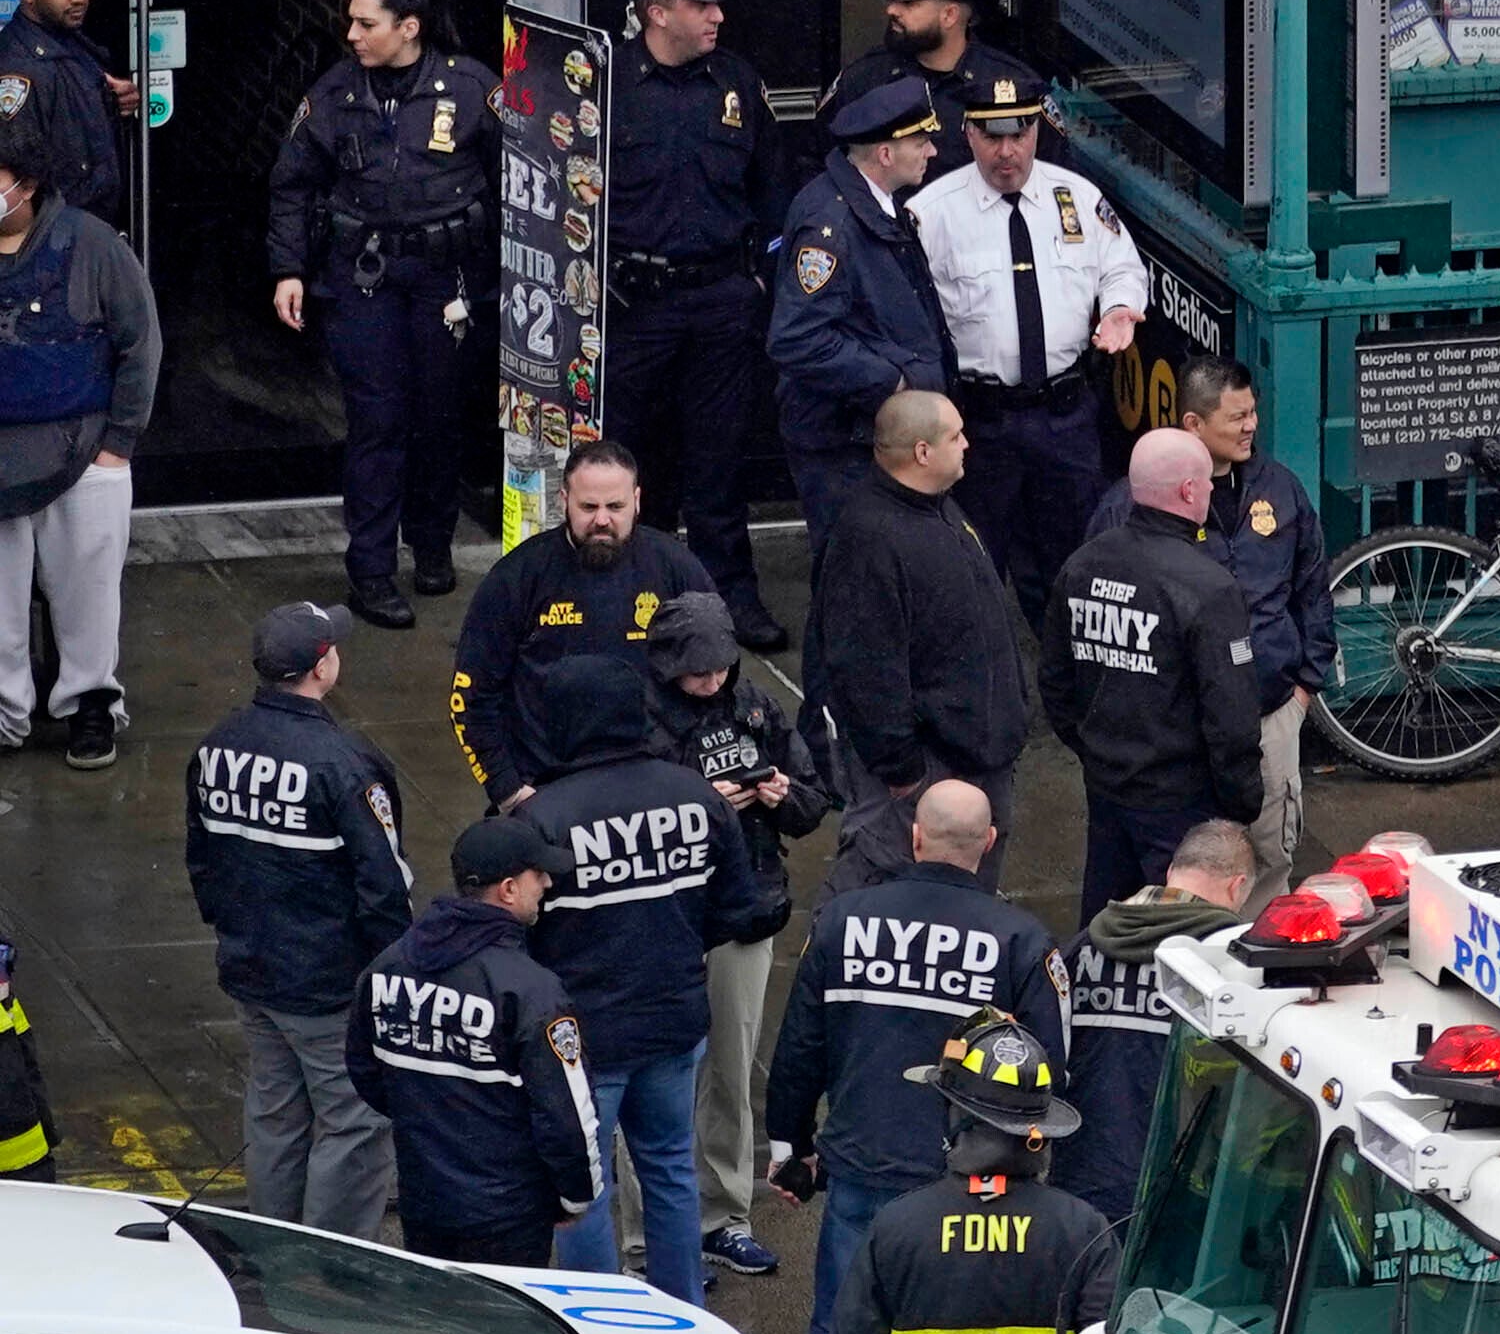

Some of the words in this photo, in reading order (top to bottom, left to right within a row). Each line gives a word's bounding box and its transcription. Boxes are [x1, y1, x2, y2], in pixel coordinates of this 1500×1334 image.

[1162, 273, 1221, 357] Station
[1360, 351, 1412, 367] Bicycles
[1417, 351, 1430, 361] or
[1434, 348, 1467, 361] other
[1360, 366, 1416, 382] attached
[1420, 367, 1433, 378] to
[1438, 364, 1472, 376] these
[1360, 385, 1377, 398] be
[1381, 381, 1435, 397] removed
[1439, 380, 1462, 393] and
[1361, 400, 1380, 414] the
[1385, 398, 1413, 412] Lost
[1417, 395, 1470, 413] Property
[1474, 392, 1499, 406] Unit
[1360, 415, 1407, 430] located
[1411, 415, 1423, 427] at
[1428, 412, 1445, 425] 34
[1450, 411, 1464, 424] St
[1395, 429, 1426, 444] (212)
[1090, 577, 1137, 604] CHIEF
[540, 613, 583, 626] POLICE
[548, 602, 574, 616] ATF
[1068, 597, 1159, 652] FDNY
[199, 746, 308, 804] NYPD
[704, 751, 740, 774] ATF
[199, 786, 308, 830] POLICE
[569, 802, 709, 866] NYPD
[575, 843, 709, 890] POLICE
[843, 916, 1000, 973] NYPD
[843, 959, 995, 1001] POLICE
[371, 973, 496, 1039] NYPD
[941, 1214, 1032, 1253] FDNY
